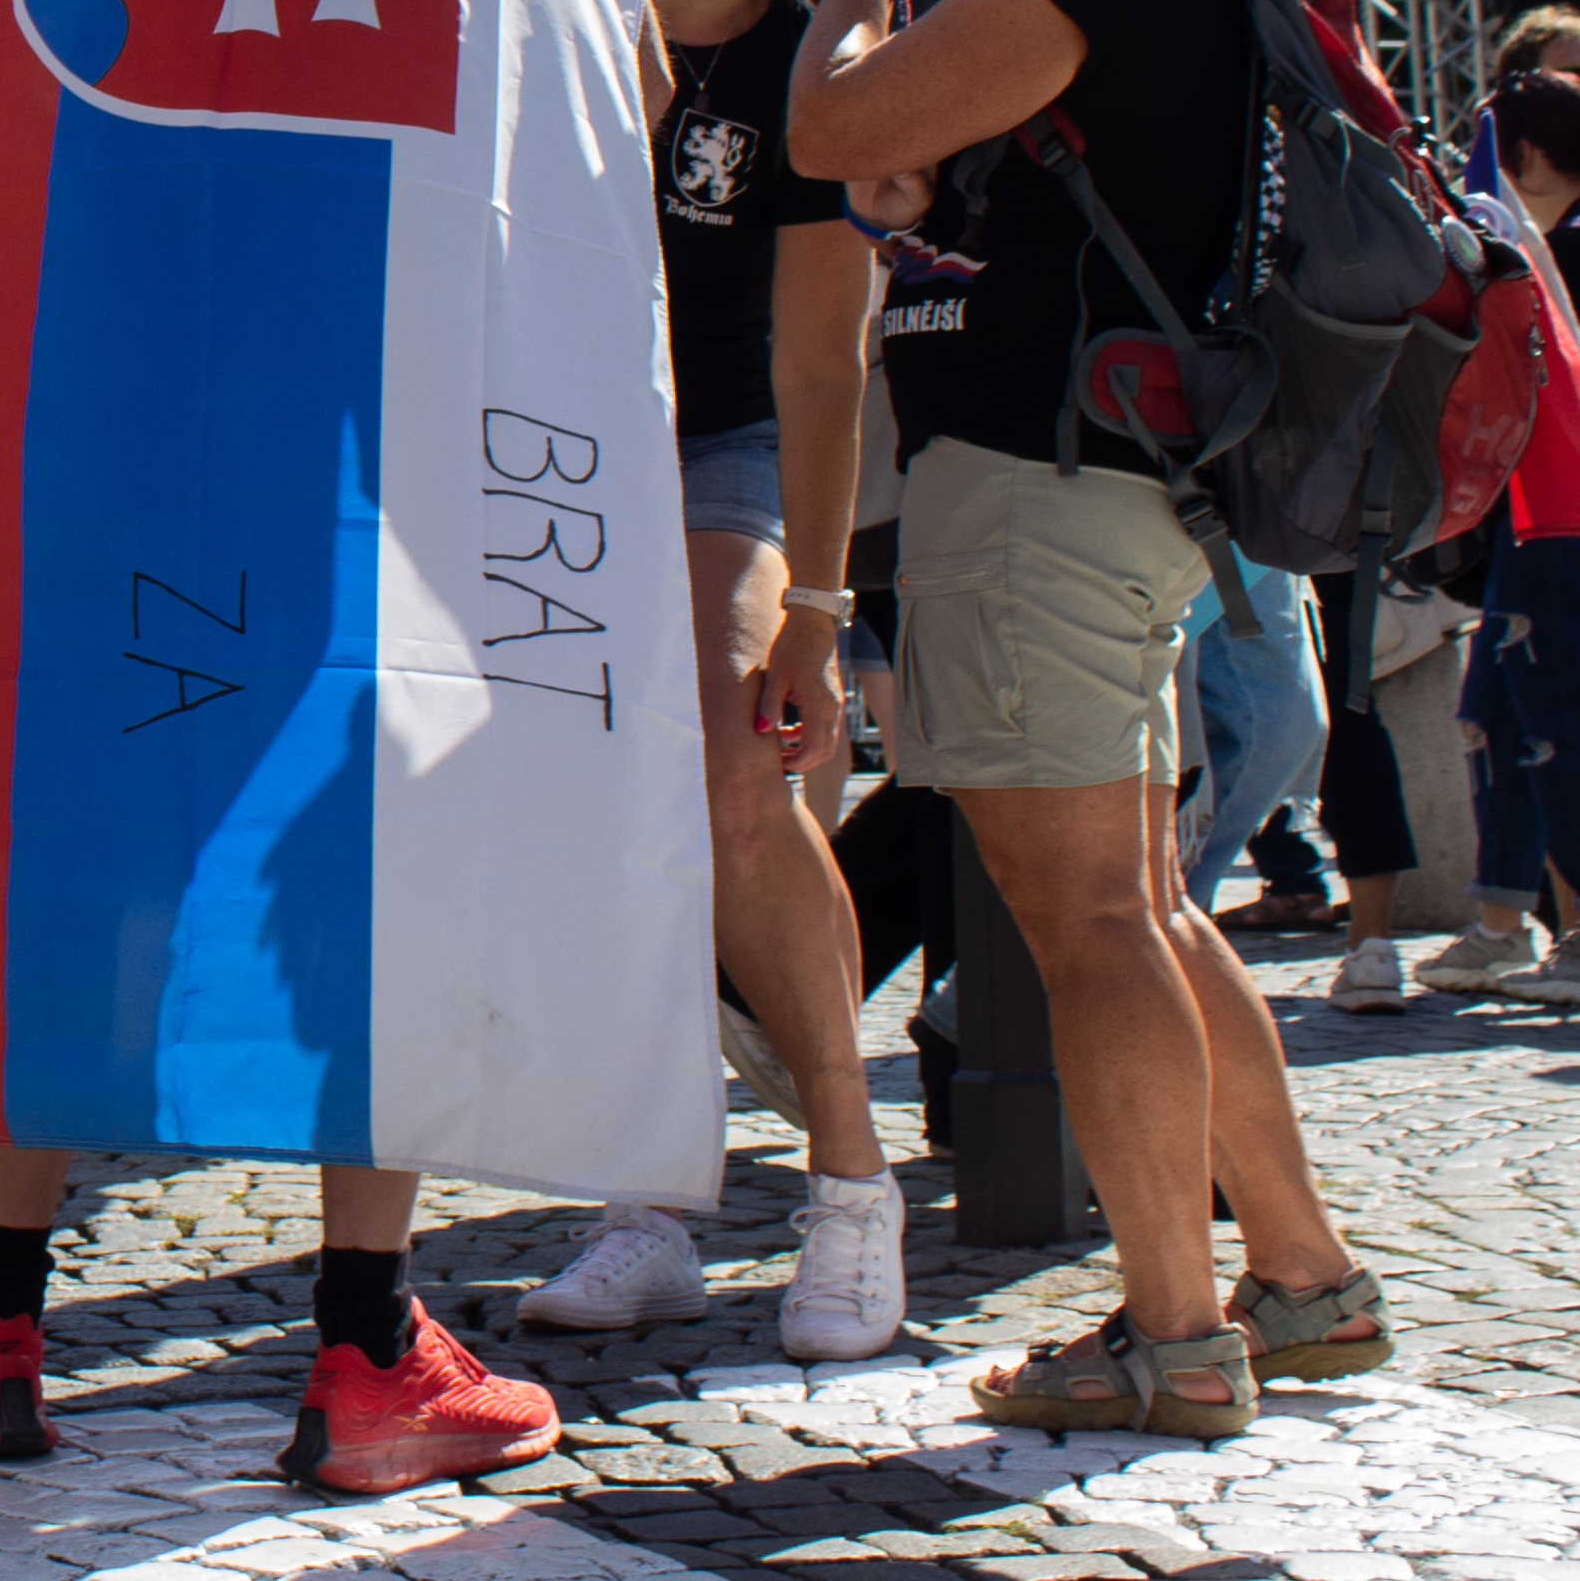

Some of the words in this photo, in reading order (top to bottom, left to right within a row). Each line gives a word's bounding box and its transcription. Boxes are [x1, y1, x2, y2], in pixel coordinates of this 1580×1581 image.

[663, 194, 734, 226] Bohemia
[122, 569, 247, 736] ZA
[480, 406, 615, 732] BRAT
